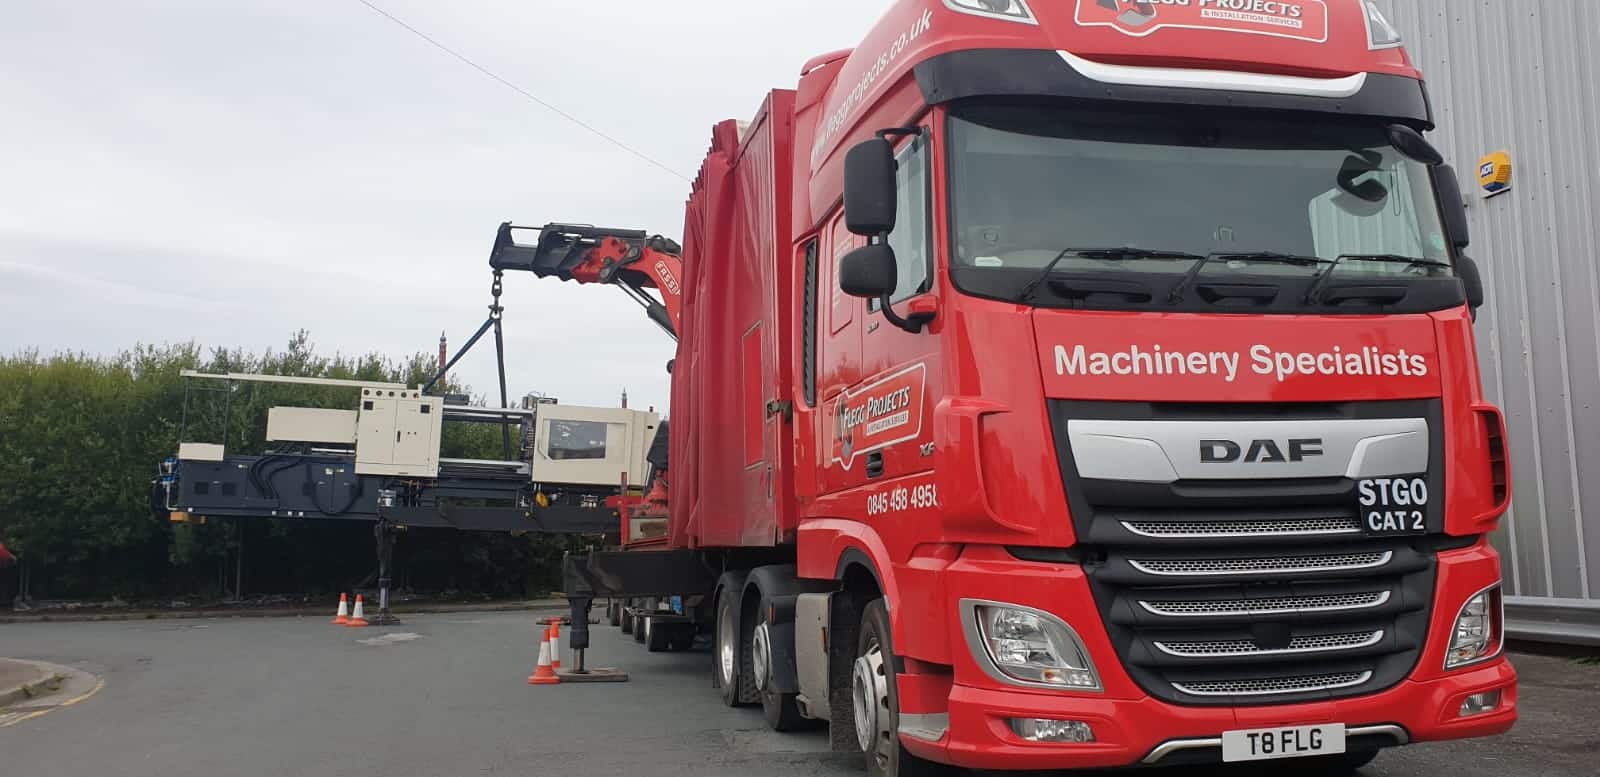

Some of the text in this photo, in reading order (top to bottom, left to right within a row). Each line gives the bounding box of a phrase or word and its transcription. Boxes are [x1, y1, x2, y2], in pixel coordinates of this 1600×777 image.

[811, 8, 932, 160] fleggprojects.co.uk
[1054, 344, 1428, 382] Machinery Specialists
[843, 404, 865, 428] FLEGG
[866, 386, 911, 420] PROJECTS
[1199, 438, 1323, 463] DAF
[867, 492, 888, 516] 0845
[890, 487, 908, 512] 458
[1358, 478, 1427, 506] STGO
[1368, 510, 1424, 531] CAT 2
[1247, 728, 1322, 755] T8 FLG
